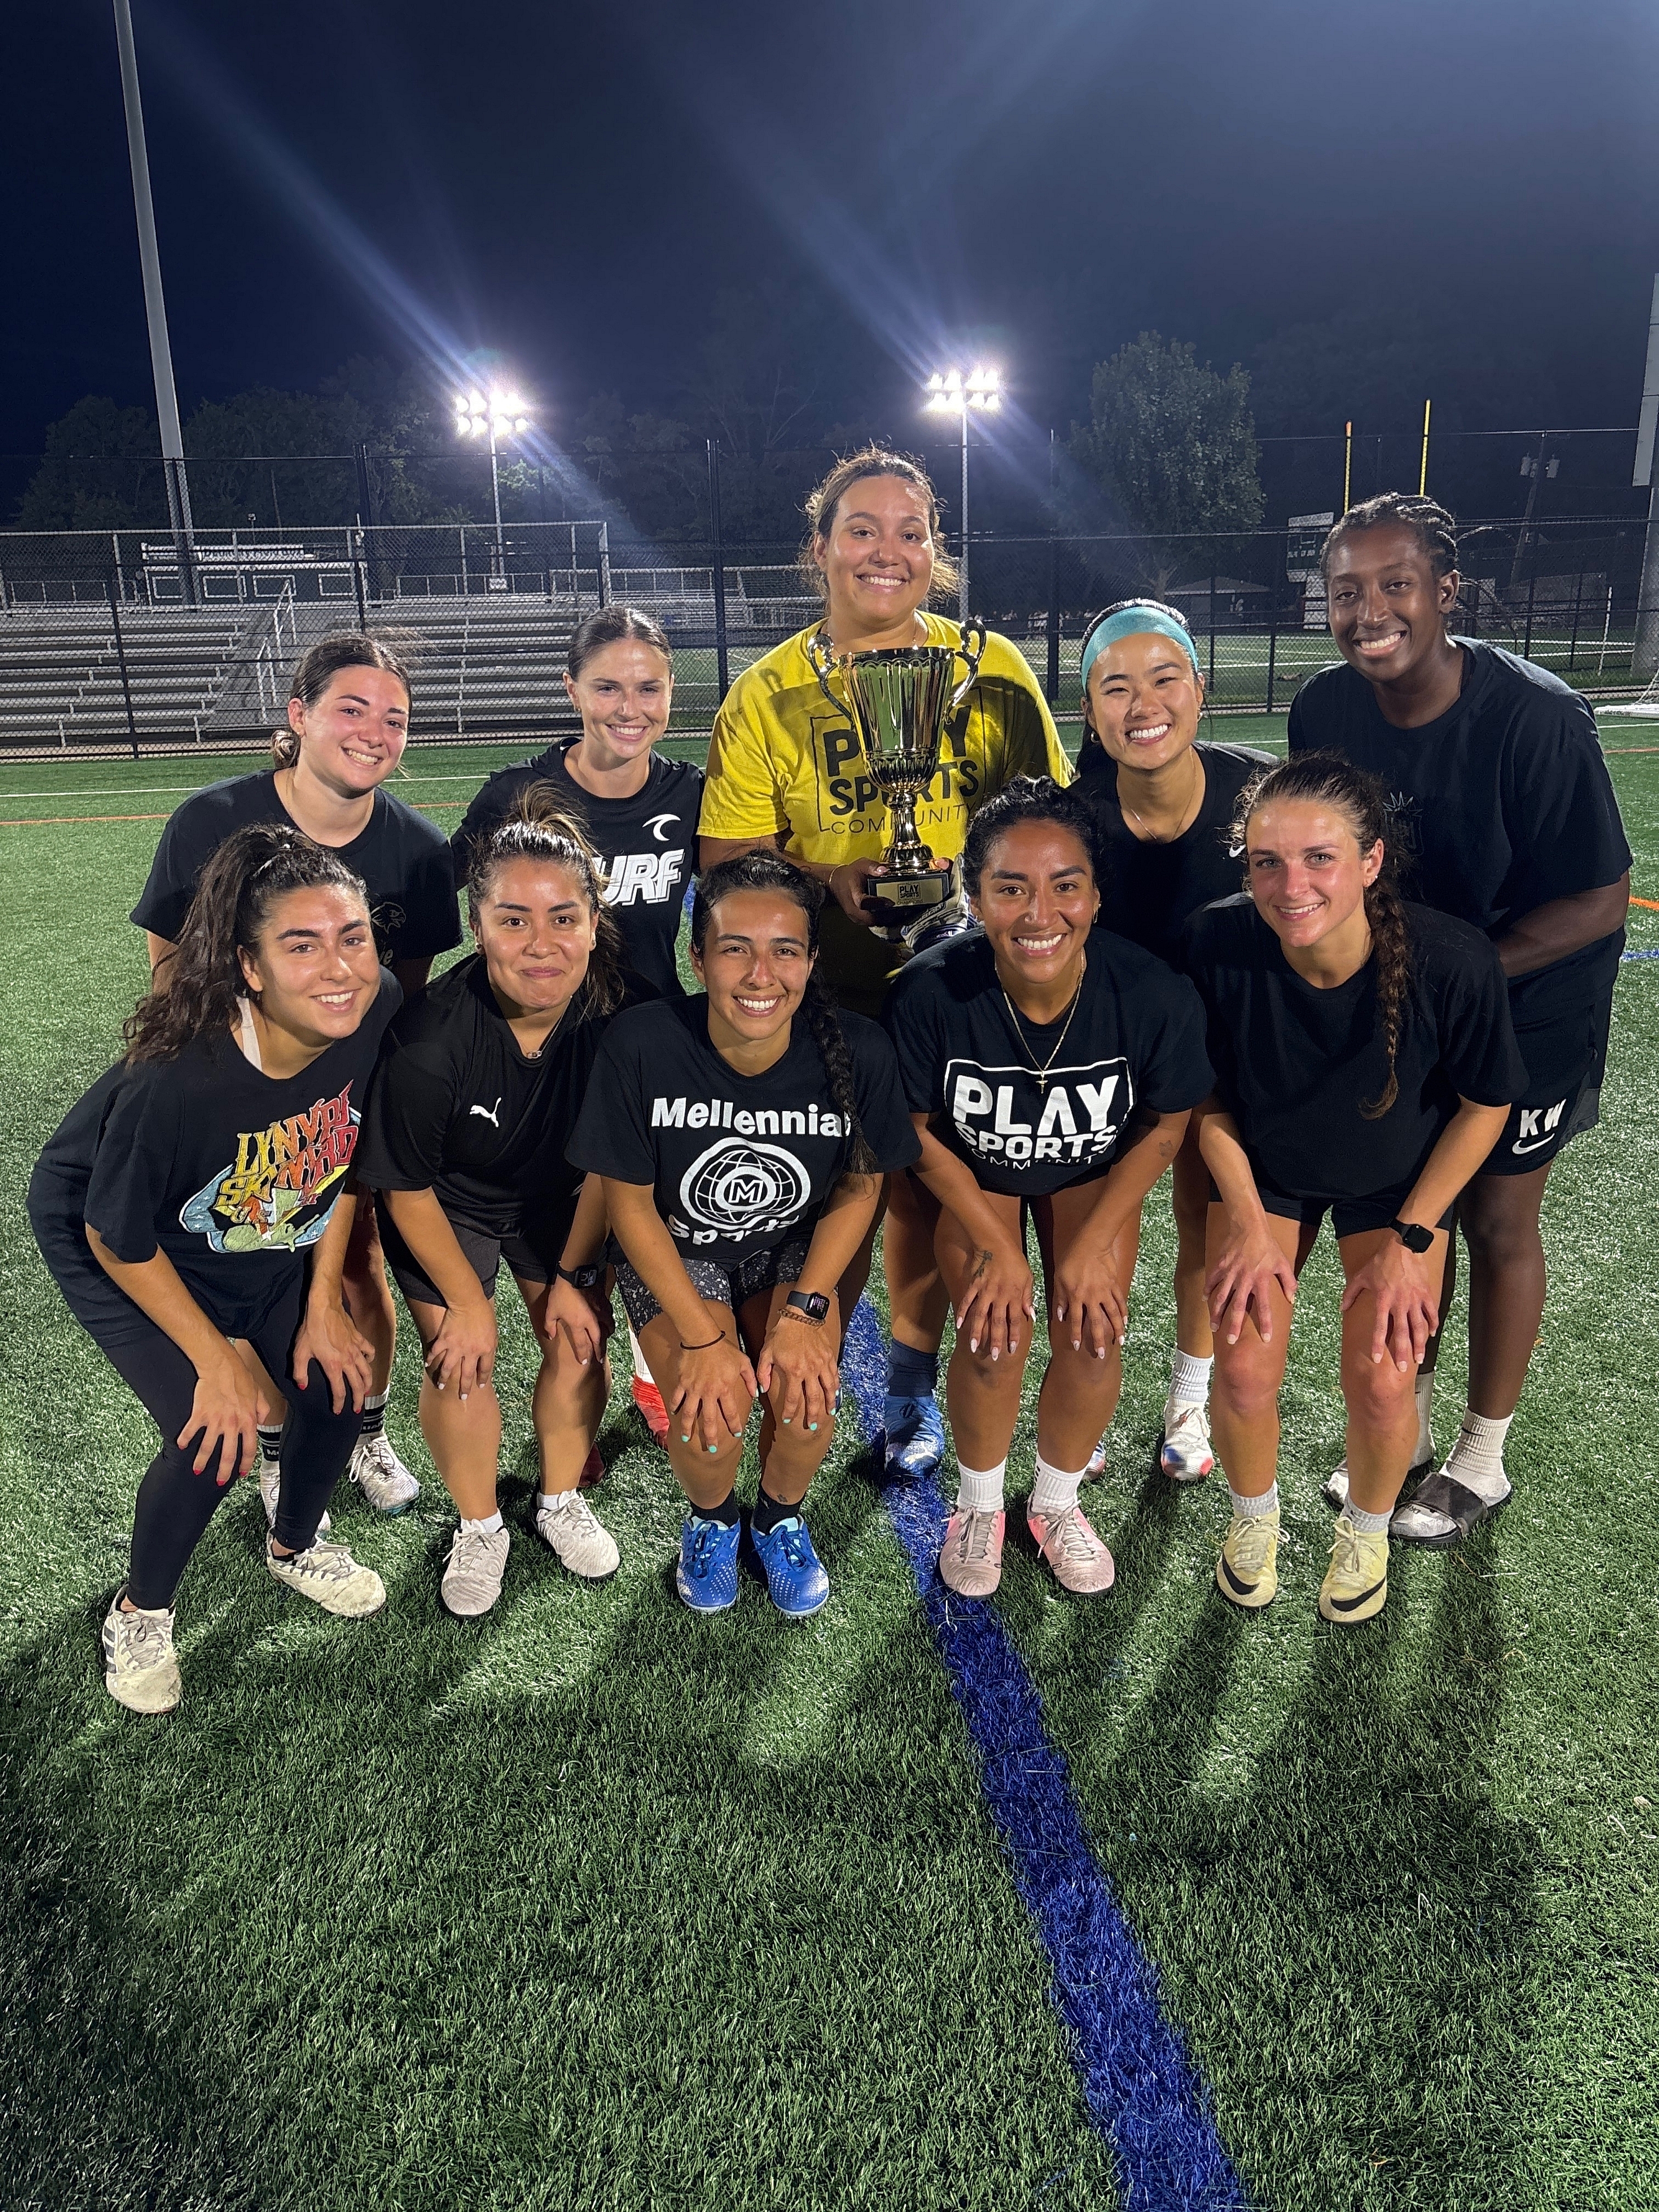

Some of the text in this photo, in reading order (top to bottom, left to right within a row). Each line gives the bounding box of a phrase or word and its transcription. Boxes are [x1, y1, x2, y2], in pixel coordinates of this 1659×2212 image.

[823, 706, 971, 777] PY
[830, 760, 979, 815] SPTS
[831, 802, 976, 834] COMUNITY
[900, 885, 918, 893] PLAY
[953, 1075, 1119, 1136] PLAY
[955, 1121, 1116, 1159] SPORTS
[728, 1180, 763, 1203] M
